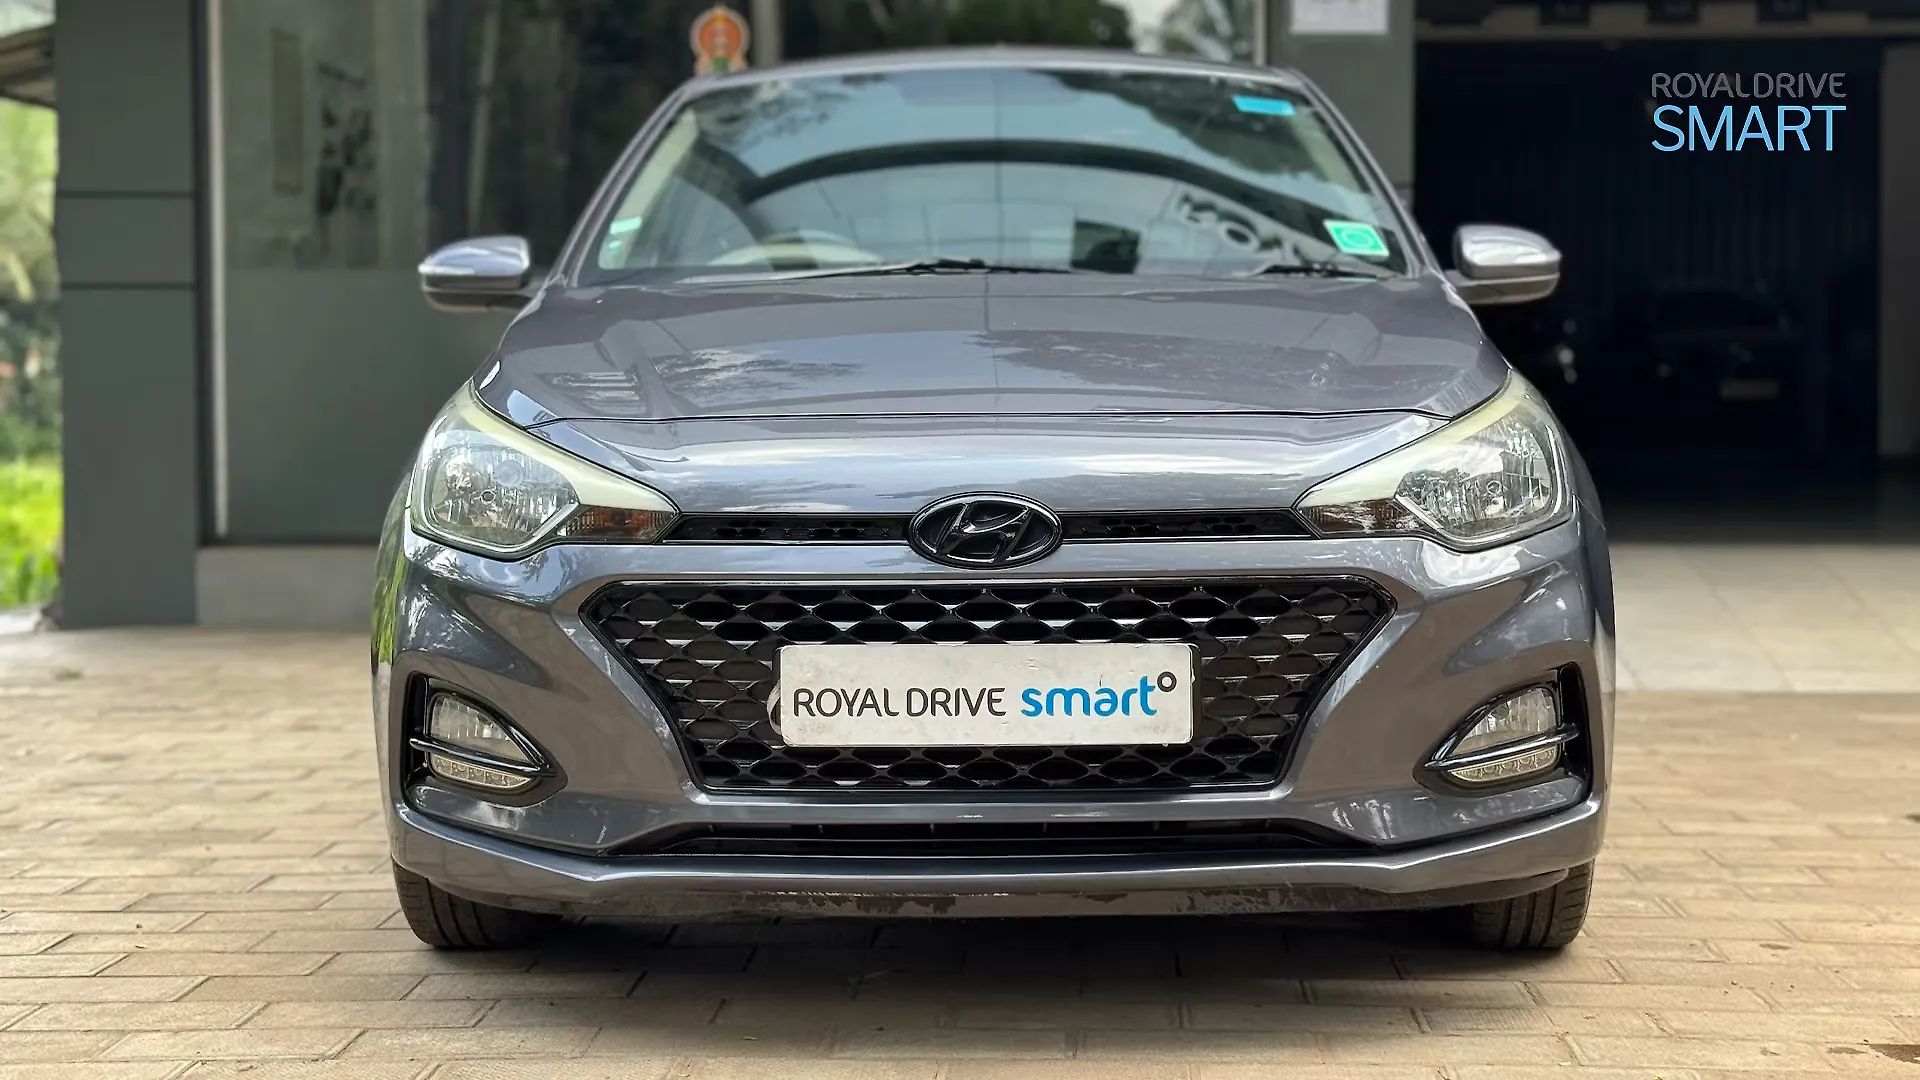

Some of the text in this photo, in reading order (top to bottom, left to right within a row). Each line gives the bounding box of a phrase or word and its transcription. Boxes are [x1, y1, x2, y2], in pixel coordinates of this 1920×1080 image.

[793, 675, 1158, 717] ROYAL DRIVE smart
